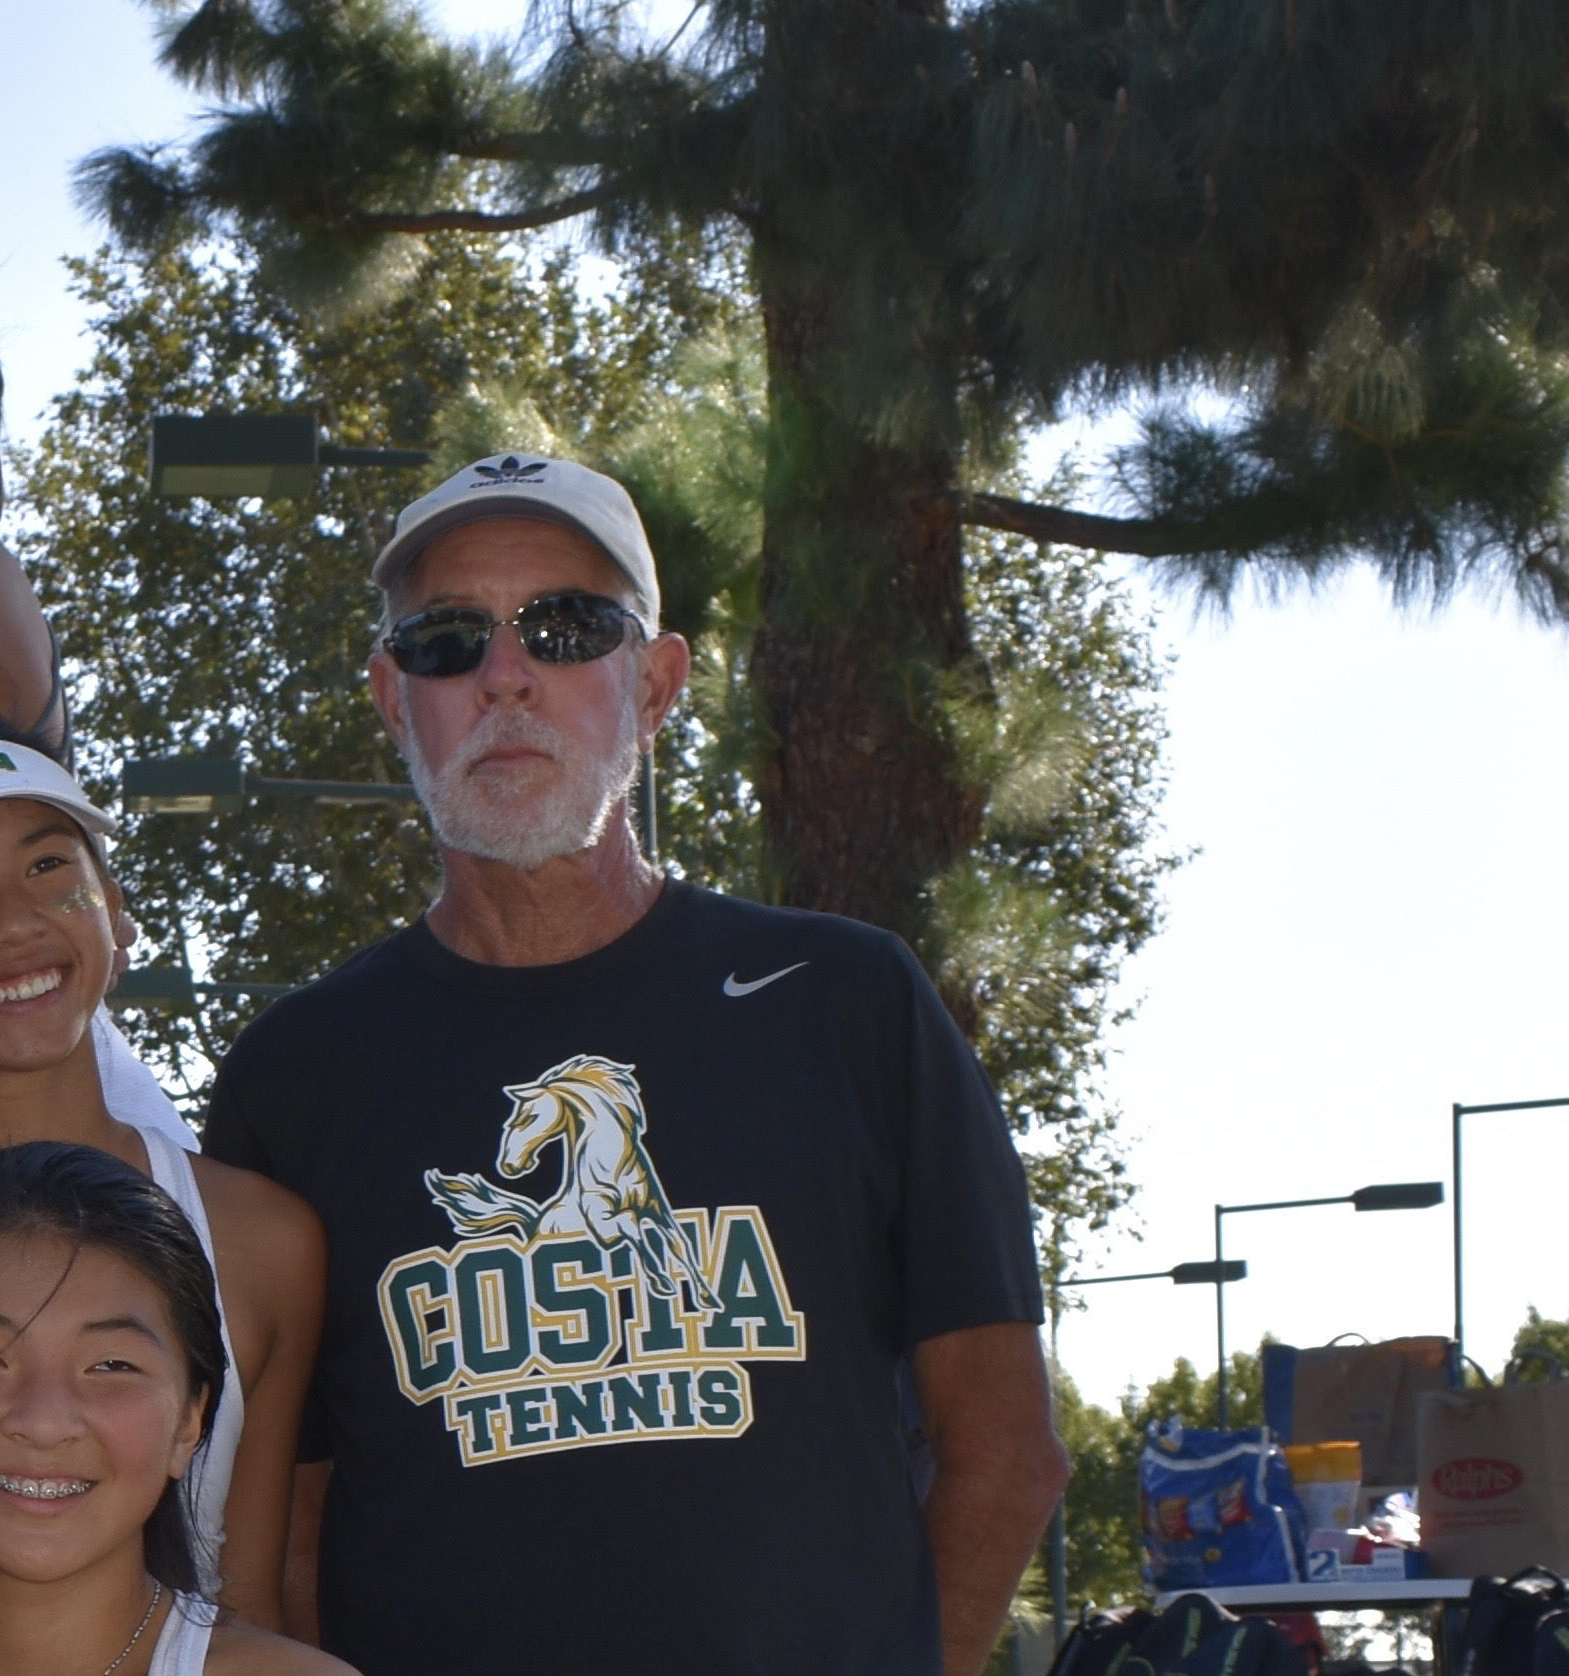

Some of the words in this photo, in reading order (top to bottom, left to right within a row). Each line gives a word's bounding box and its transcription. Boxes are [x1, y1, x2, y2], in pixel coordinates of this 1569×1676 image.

[469, 478, 545, 488] adidas
[377, 1205, 807, 1406] COSTA
[445, 1361, 755, 1467] TENNIS
